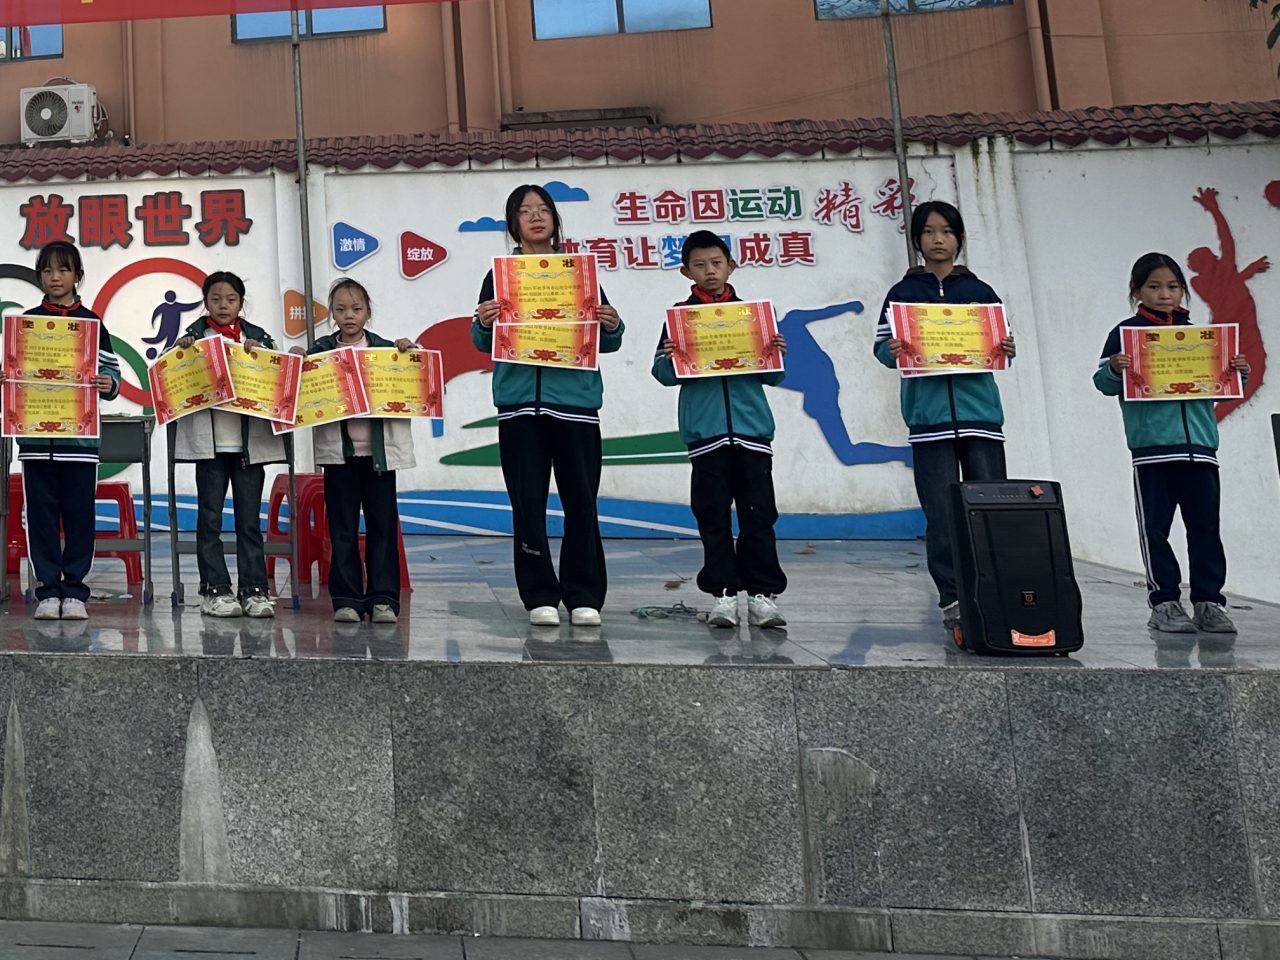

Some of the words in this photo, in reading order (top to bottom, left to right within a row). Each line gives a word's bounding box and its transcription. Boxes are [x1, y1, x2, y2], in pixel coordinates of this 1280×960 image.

[19, 188, 254, 251] 放眼世界
[339, 238, 366, 252] 激情
[406, 247, 434, 261] 绽放
[289, 305, 316, 320] 拼
